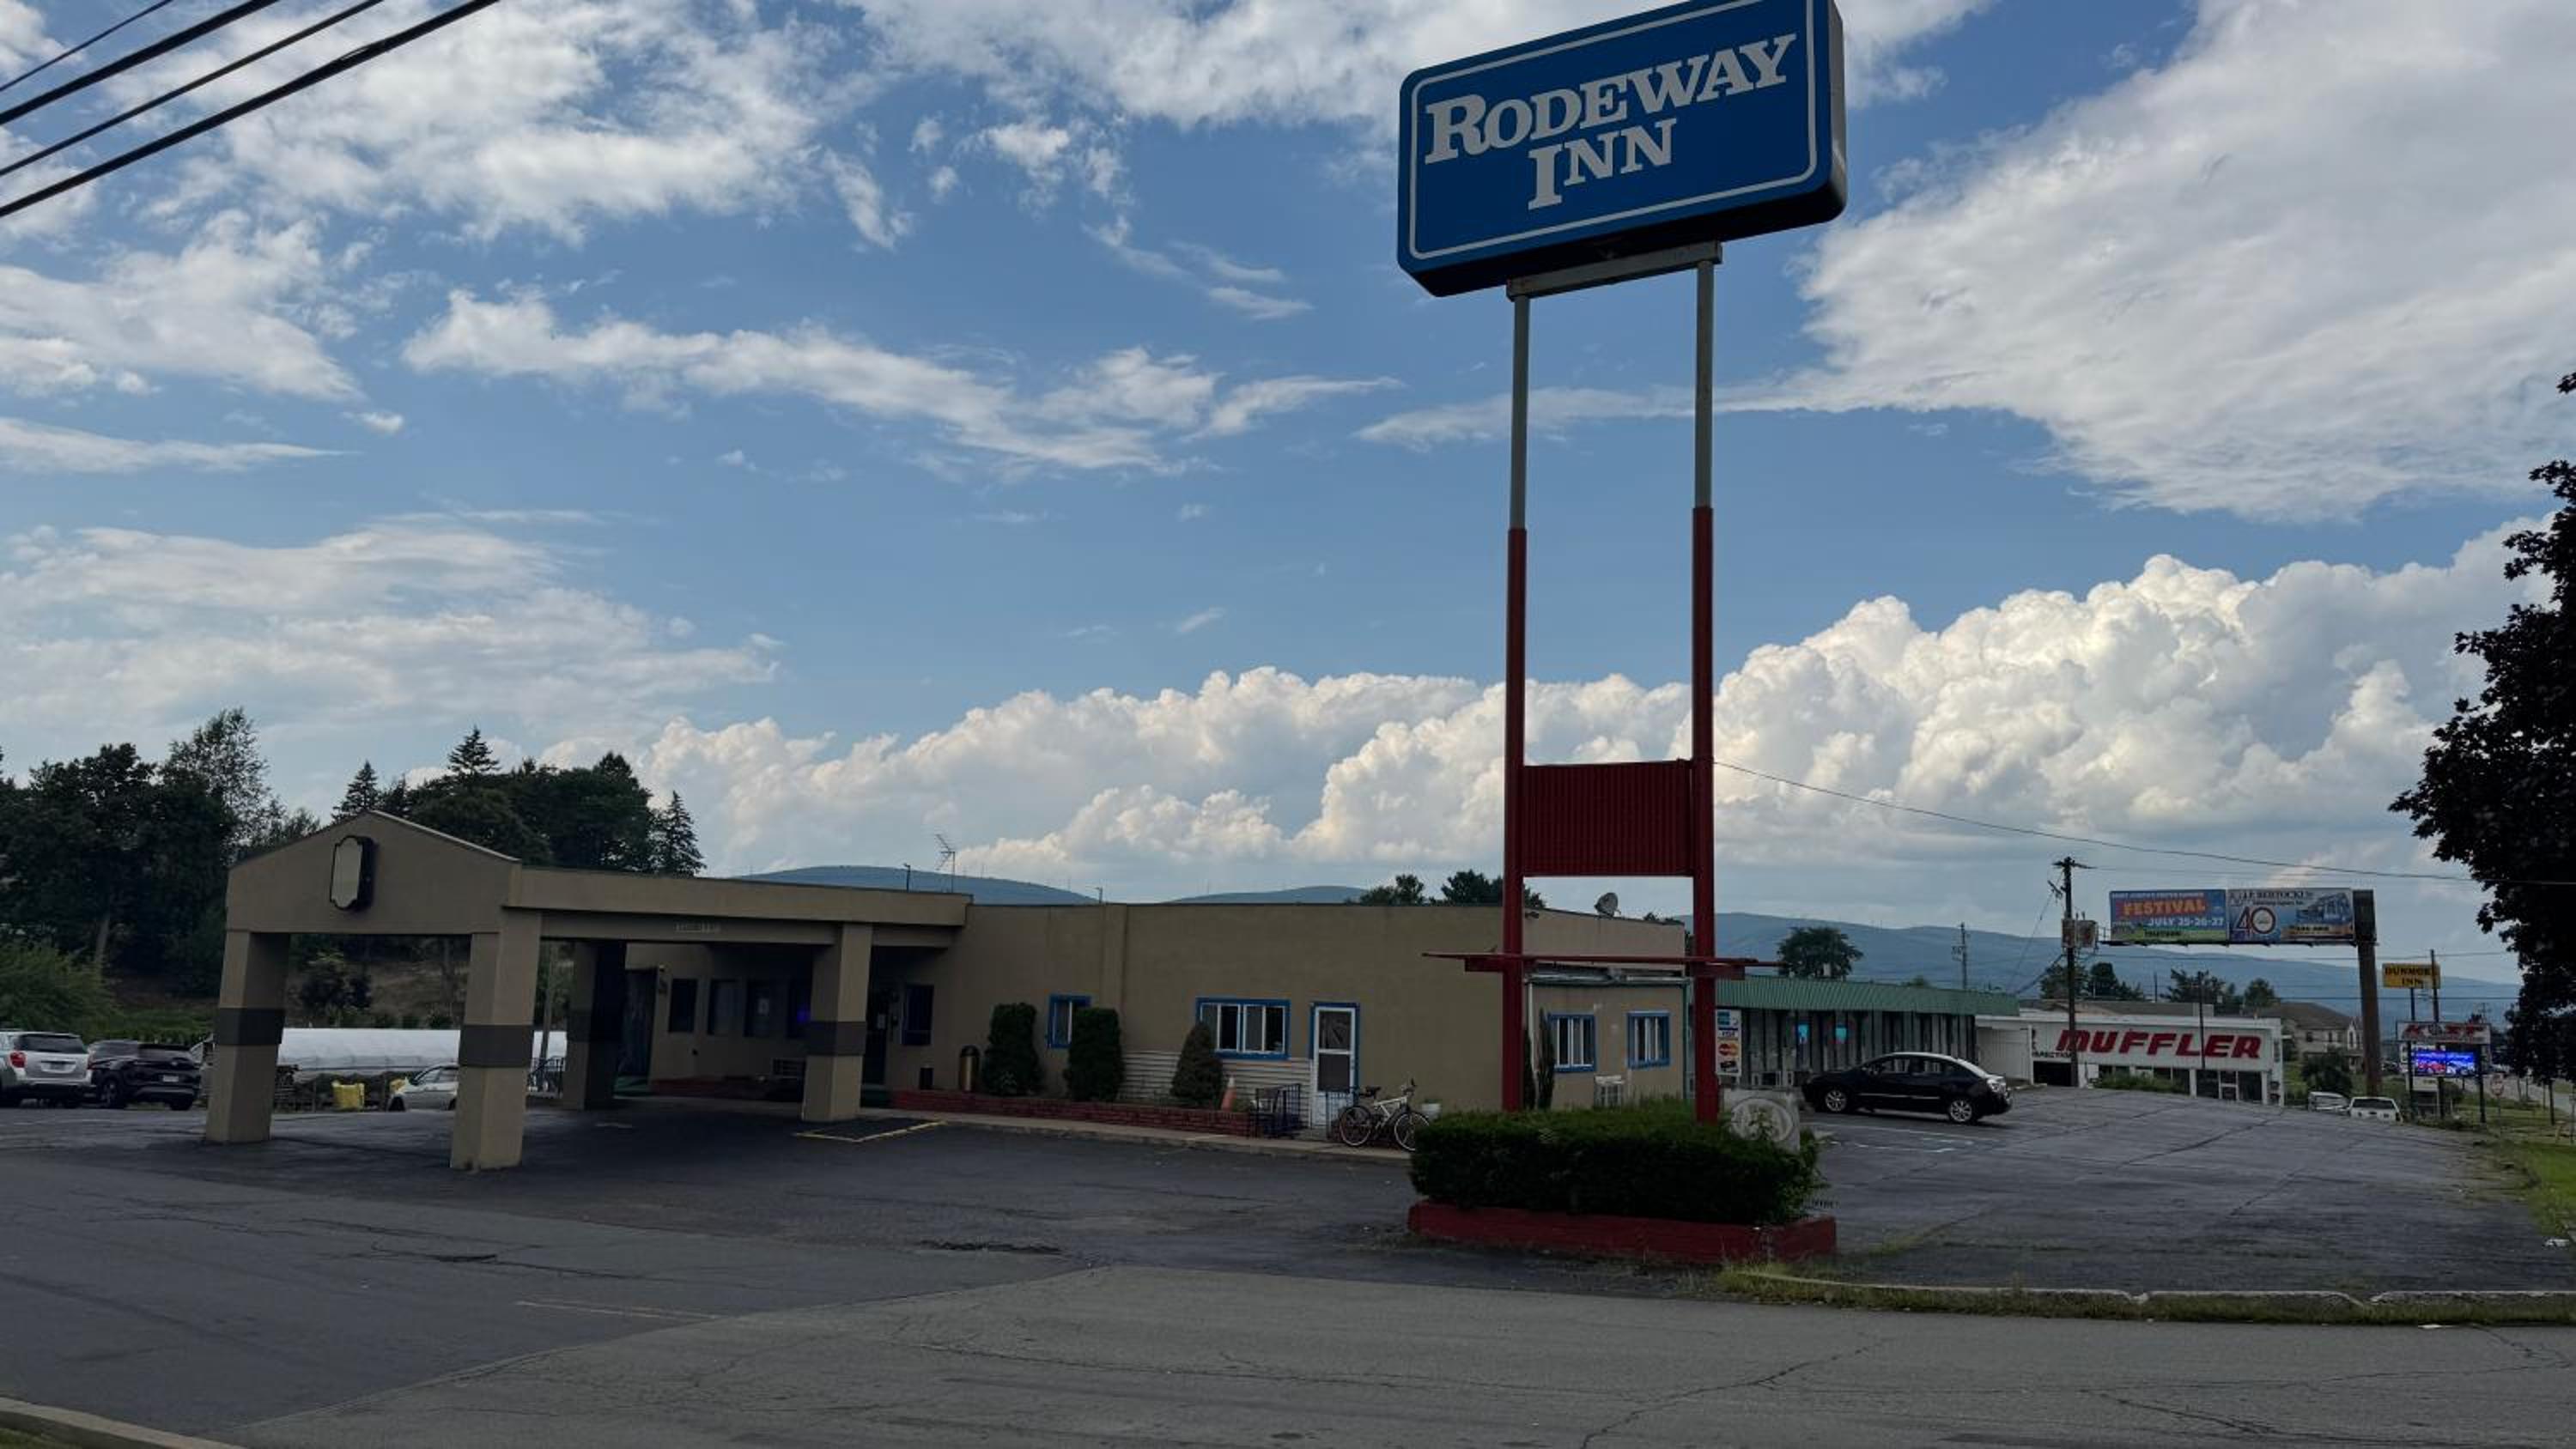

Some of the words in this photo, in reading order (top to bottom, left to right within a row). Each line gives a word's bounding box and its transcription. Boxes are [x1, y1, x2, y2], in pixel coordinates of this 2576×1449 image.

[1425, 33, 1796, 164] RODEWAY
[1528, 118, 1677, 210] INN
[2124, 900, 2206, 916] FESTIVAL
[2148, 918, 2174, 926] JULY
[2056, 1029, 2261, 1058] MUFFLER
